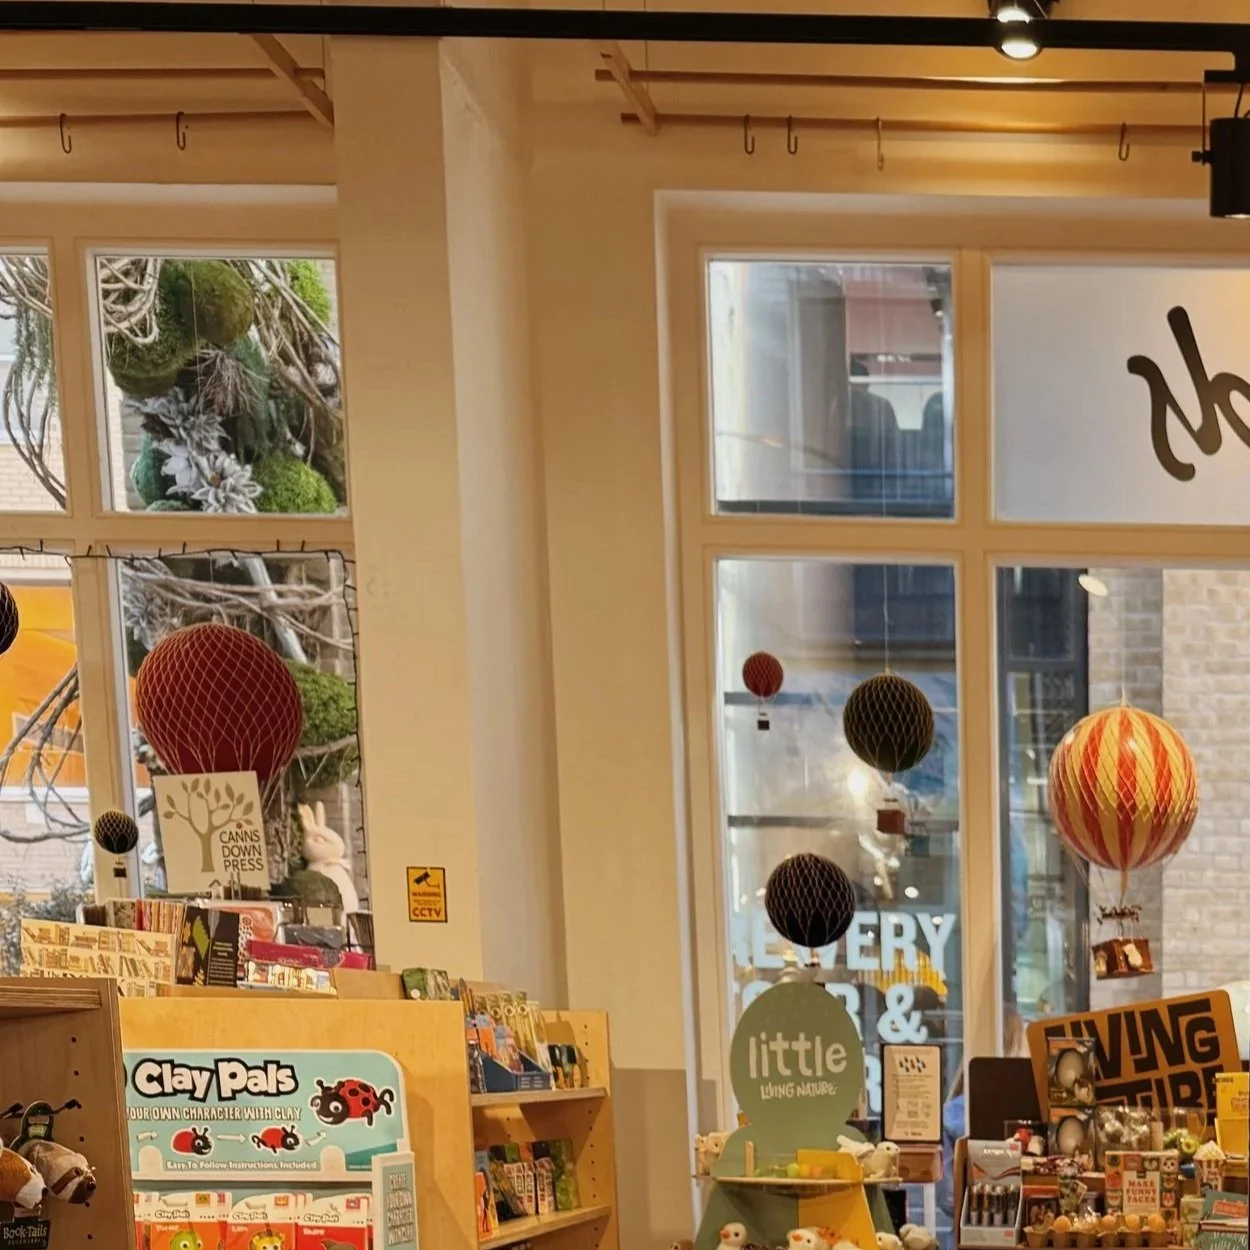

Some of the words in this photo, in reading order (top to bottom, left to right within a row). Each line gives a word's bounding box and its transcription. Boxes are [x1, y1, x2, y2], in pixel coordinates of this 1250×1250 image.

[219, 829, 261, 845] CANNS
[221, 844, 262, 858] DOWN
[223, 858, 265, 873] PRESS
[412, 907, 442, 918] CCTV
[749, 1031, 847, 1080] little
[132, 1058, 214, 1103] Clay
[214, 1057, 299, 1102] Pals
[152, 1107, 181, 1121] OWN
[182, 1107, 242, 1121] CHARACTER
[243, 1107, 273, 1121] WITH
[275, 1107, 301, 1121] CLAY
[199, 1161, 228, 1169] Follow
[279, 1161, 317, 1169] Included
